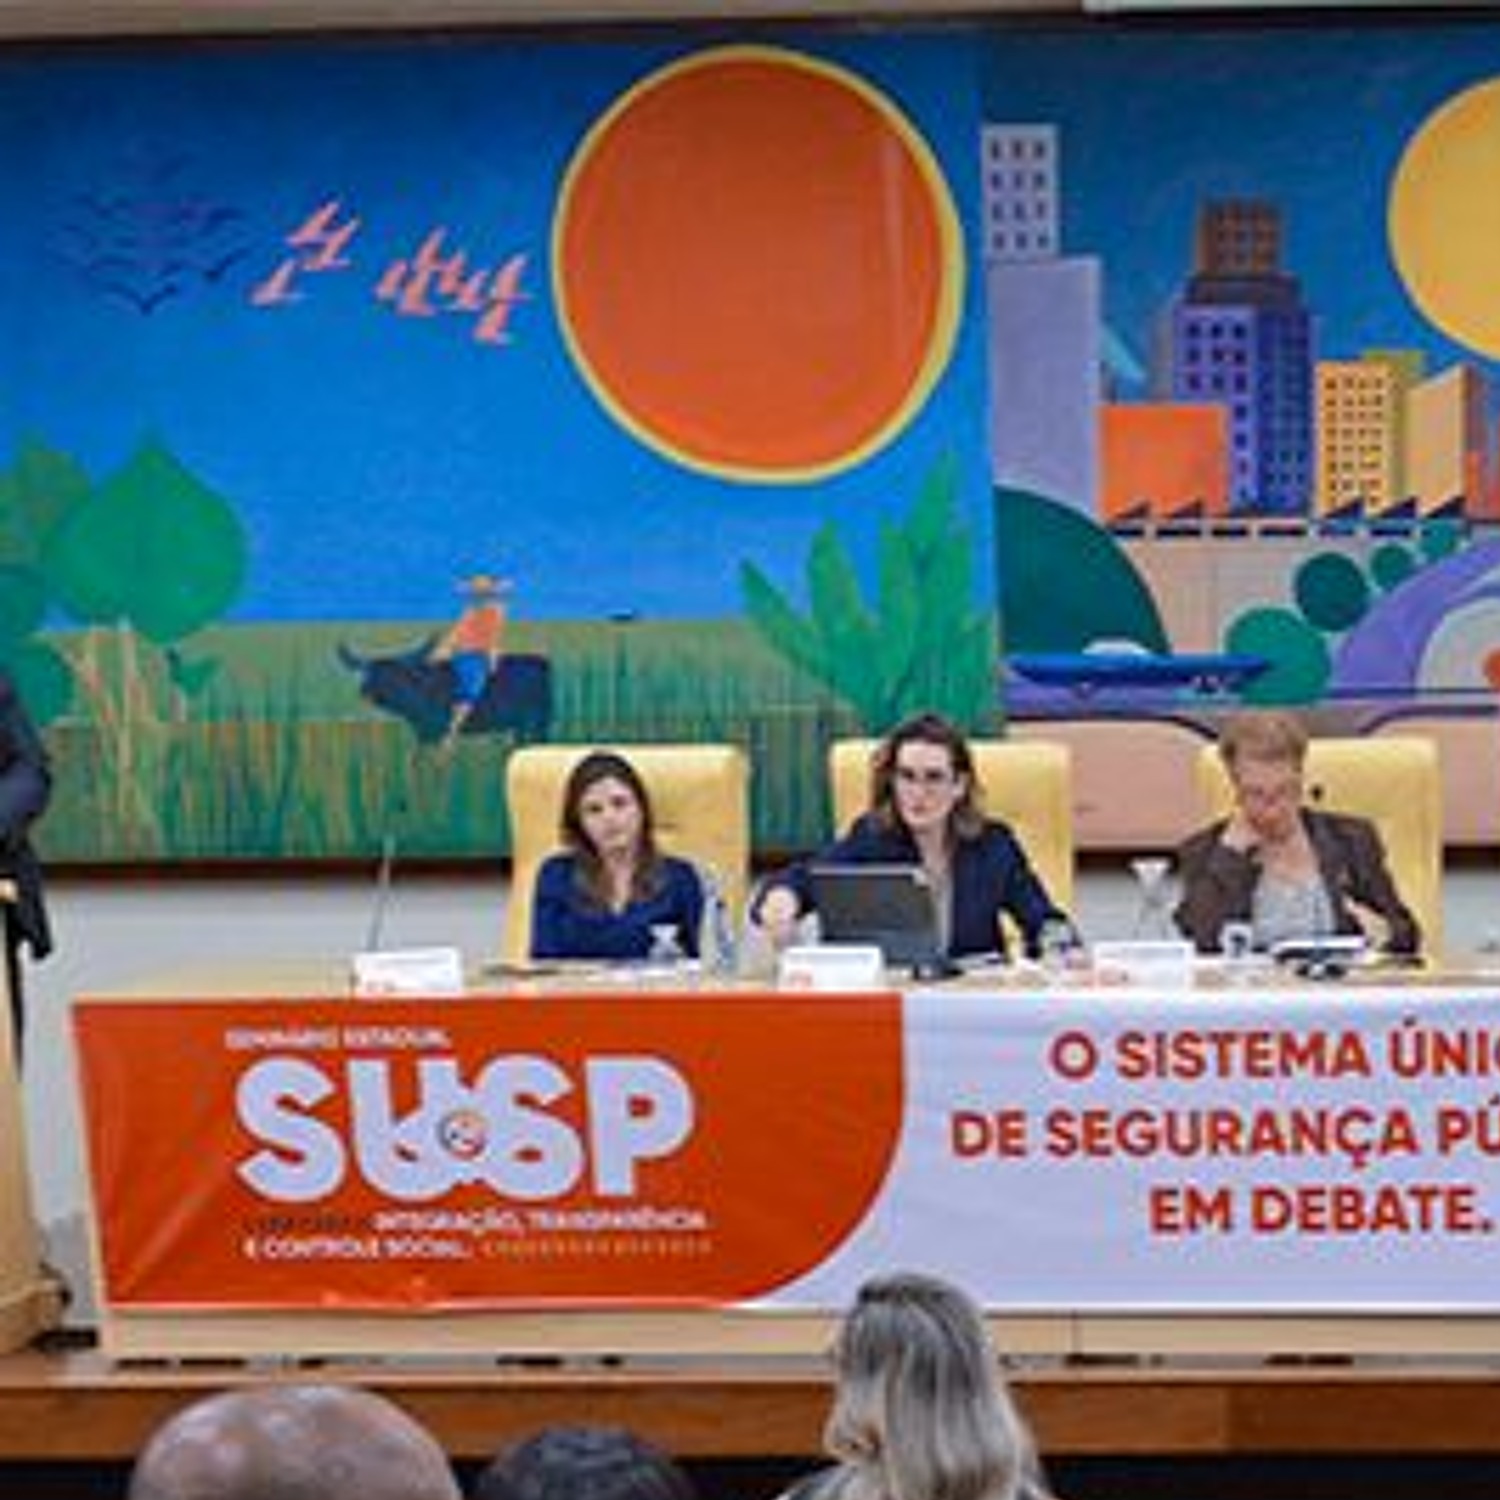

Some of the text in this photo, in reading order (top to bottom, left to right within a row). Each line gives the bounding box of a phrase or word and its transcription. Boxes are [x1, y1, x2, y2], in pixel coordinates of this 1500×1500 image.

[1050, 1032, 1097, 1080] O
[1116, 1030, 1372, 1079] SISTEMA
[235, 1054, 696, 1203] SUSP
[951, 1110, 1028, 1157] DE
[1045, 1108, 1420, 1168] SEGURANÇA
[1150, 1186, 1495, 1234] EM DEBATE.
